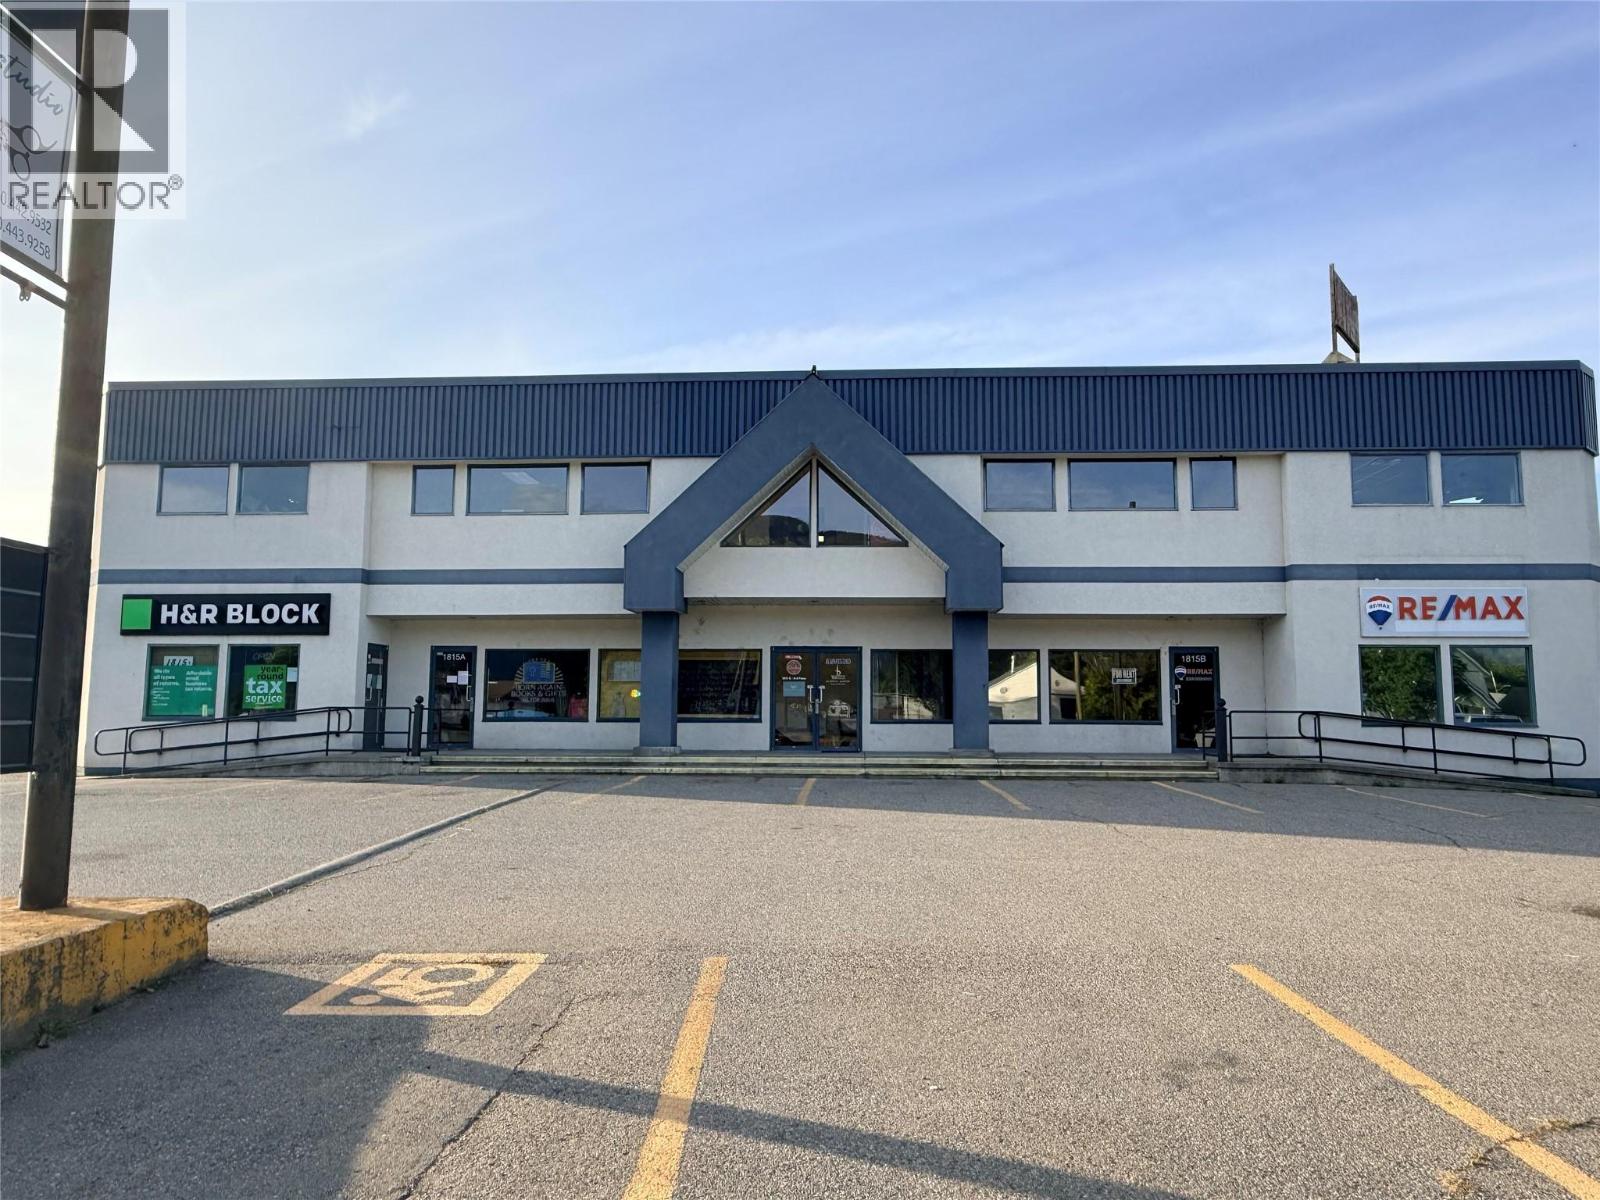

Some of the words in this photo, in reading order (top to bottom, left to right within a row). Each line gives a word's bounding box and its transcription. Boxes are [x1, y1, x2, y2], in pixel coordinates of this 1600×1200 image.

[1369, 602, 1390, 610] RE/MAX
[1397, 595, 1525, 621] RE/MAX
[160, 604, 218, 625] H&R
[226, 603, 320, 625] BLOCK
[443, 653, 466, 661] 1815A
[1181, 655, 1207, 663] 1815B
[245, 677, 283, 694] tax
[245, 693, 283, 703] service
